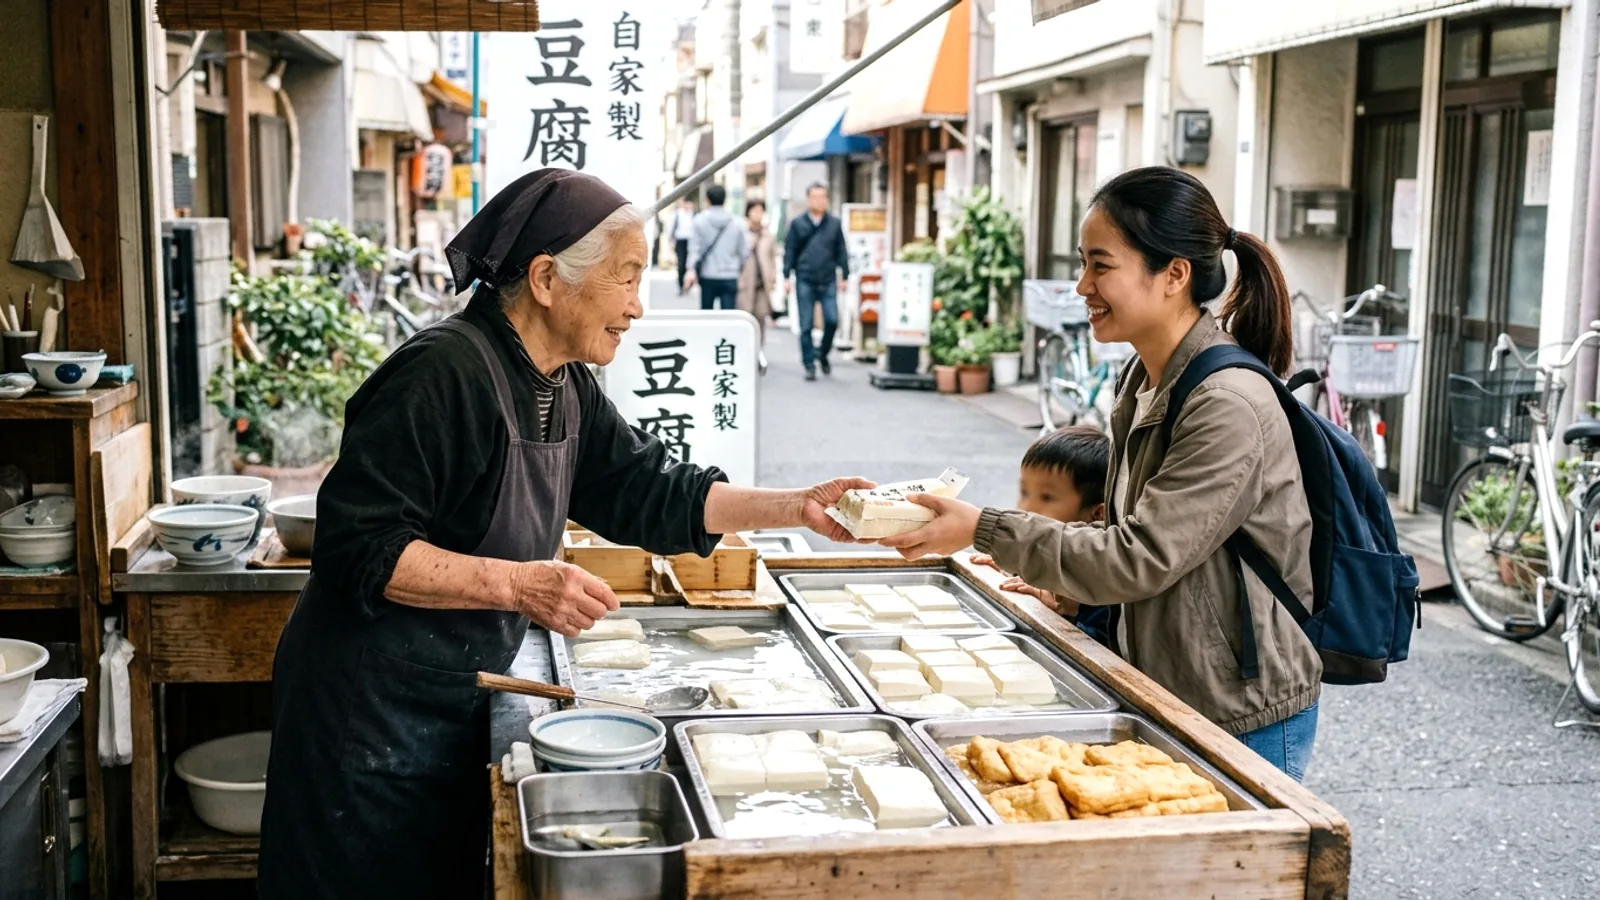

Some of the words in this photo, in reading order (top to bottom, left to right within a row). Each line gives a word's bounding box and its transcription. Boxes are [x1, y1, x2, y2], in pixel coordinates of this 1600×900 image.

[523, 19, 592, 170] 豆腐
[607, 11, 645, 141] 自家製
[712, 338, 739, 431] 自家製
